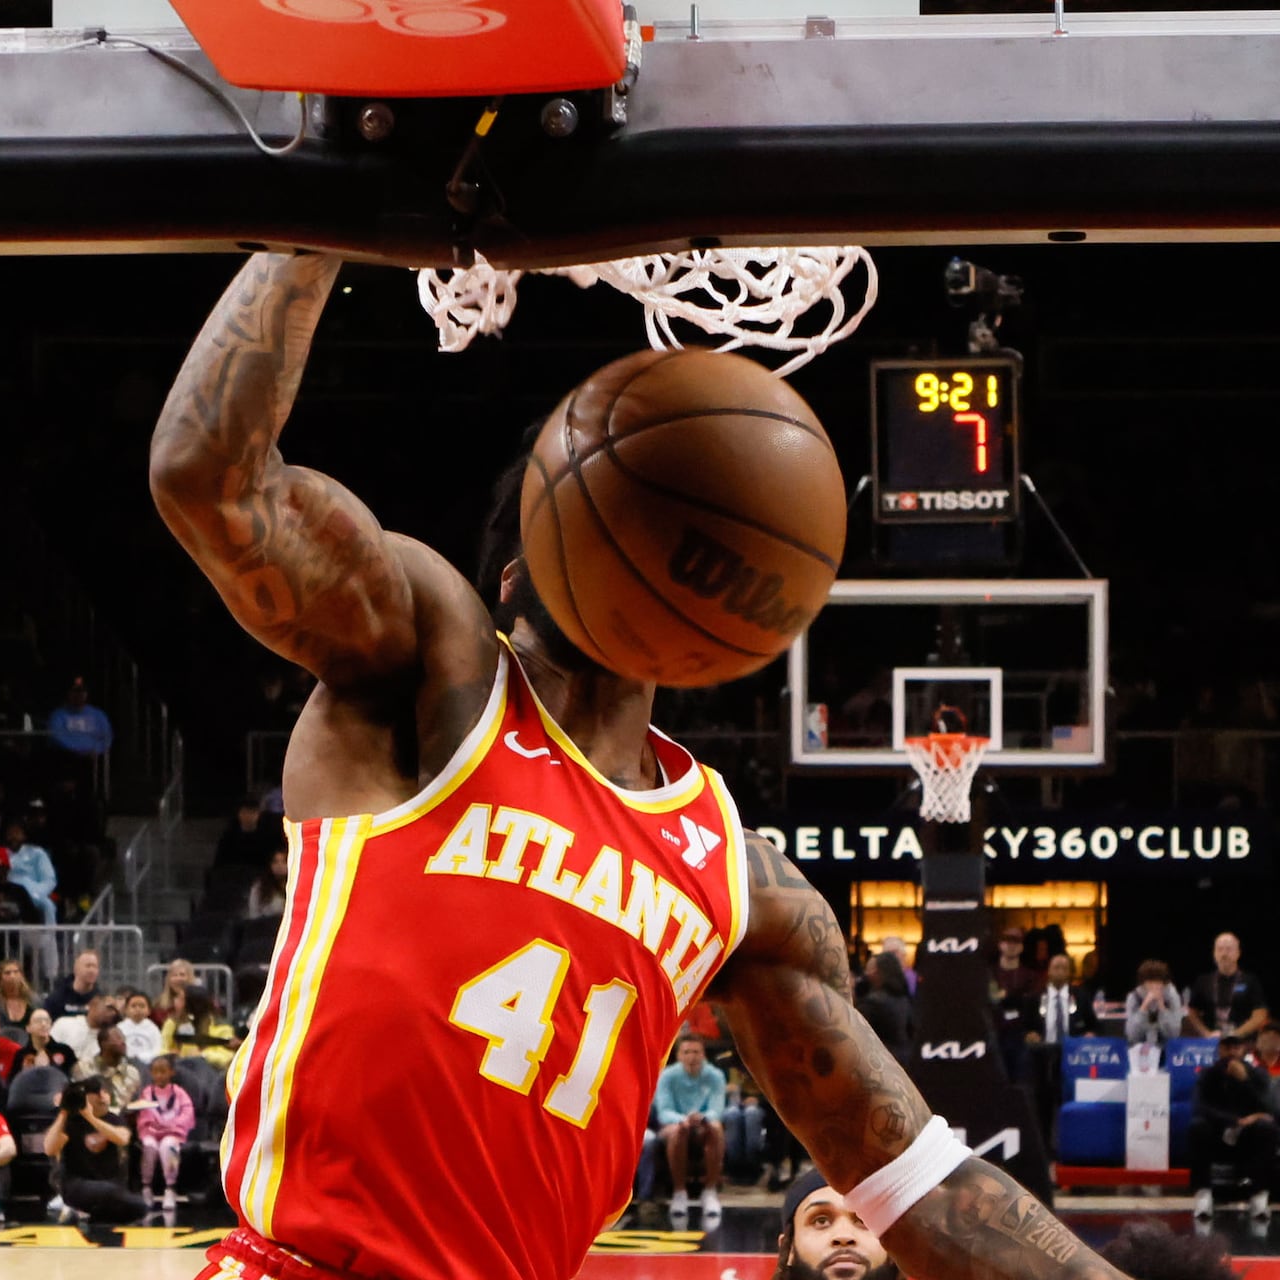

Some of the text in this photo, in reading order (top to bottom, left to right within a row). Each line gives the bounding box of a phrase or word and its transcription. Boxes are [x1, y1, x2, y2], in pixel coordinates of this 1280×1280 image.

[915, 373, 998, 412] 9:21
[953, 413, 987, 473] 7
[920, 490, 1010, 510] TISSOT
[661, 827, 681, 848] the
[756, 826, 923, 859] DELTA
[424, 803, 723, 1016] ATLANTA
[448, 938, 638, 1130] 41
[1172, 1054, 1214, 1066] ULTR
